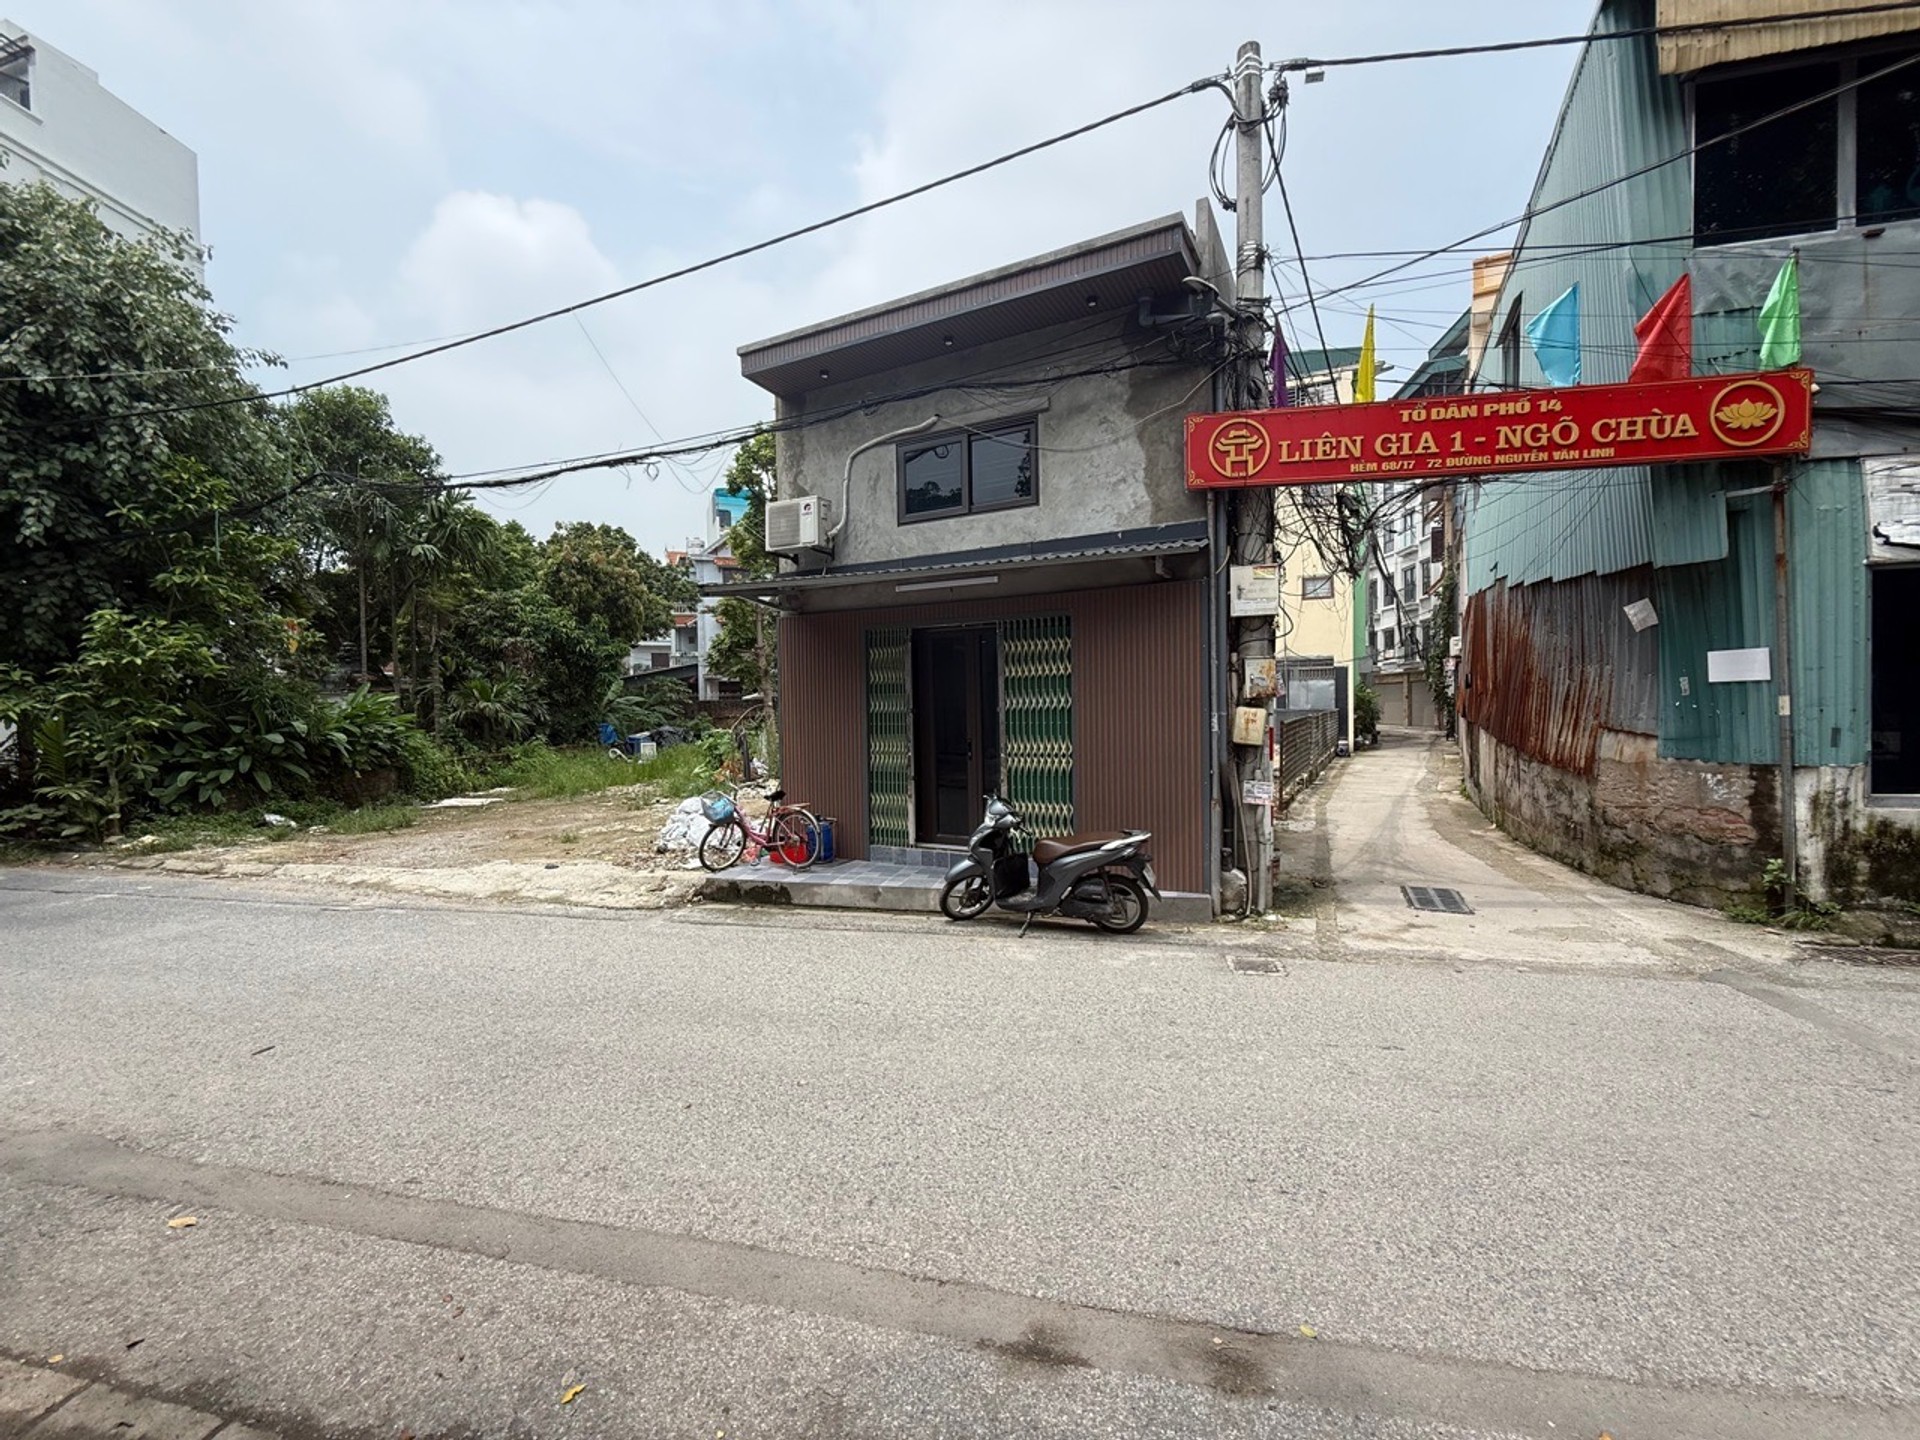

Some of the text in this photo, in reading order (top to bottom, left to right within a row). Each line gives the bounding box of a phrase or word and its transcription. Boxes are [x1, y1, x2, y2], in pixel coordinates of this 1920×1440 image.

[1400, 396, 1562, 422] TỔ DÂN PHỐ 14
[1279, 431, 1364, 463] LIÊN
[1374, 431, 1440, 456] GIA
[1451, 431, 1465, 452] 1
[1495, 416, 1580, 449] NGÕ
[1591, 408, 1699, 444] CHÙA
[1381, 460, 1415, 471] 68/17
[1427, 458, 1442, 468] 72
[1446, 453, 1492, 467] ĐƯỜNG
[1582, 447, 1615, 459] LINH
